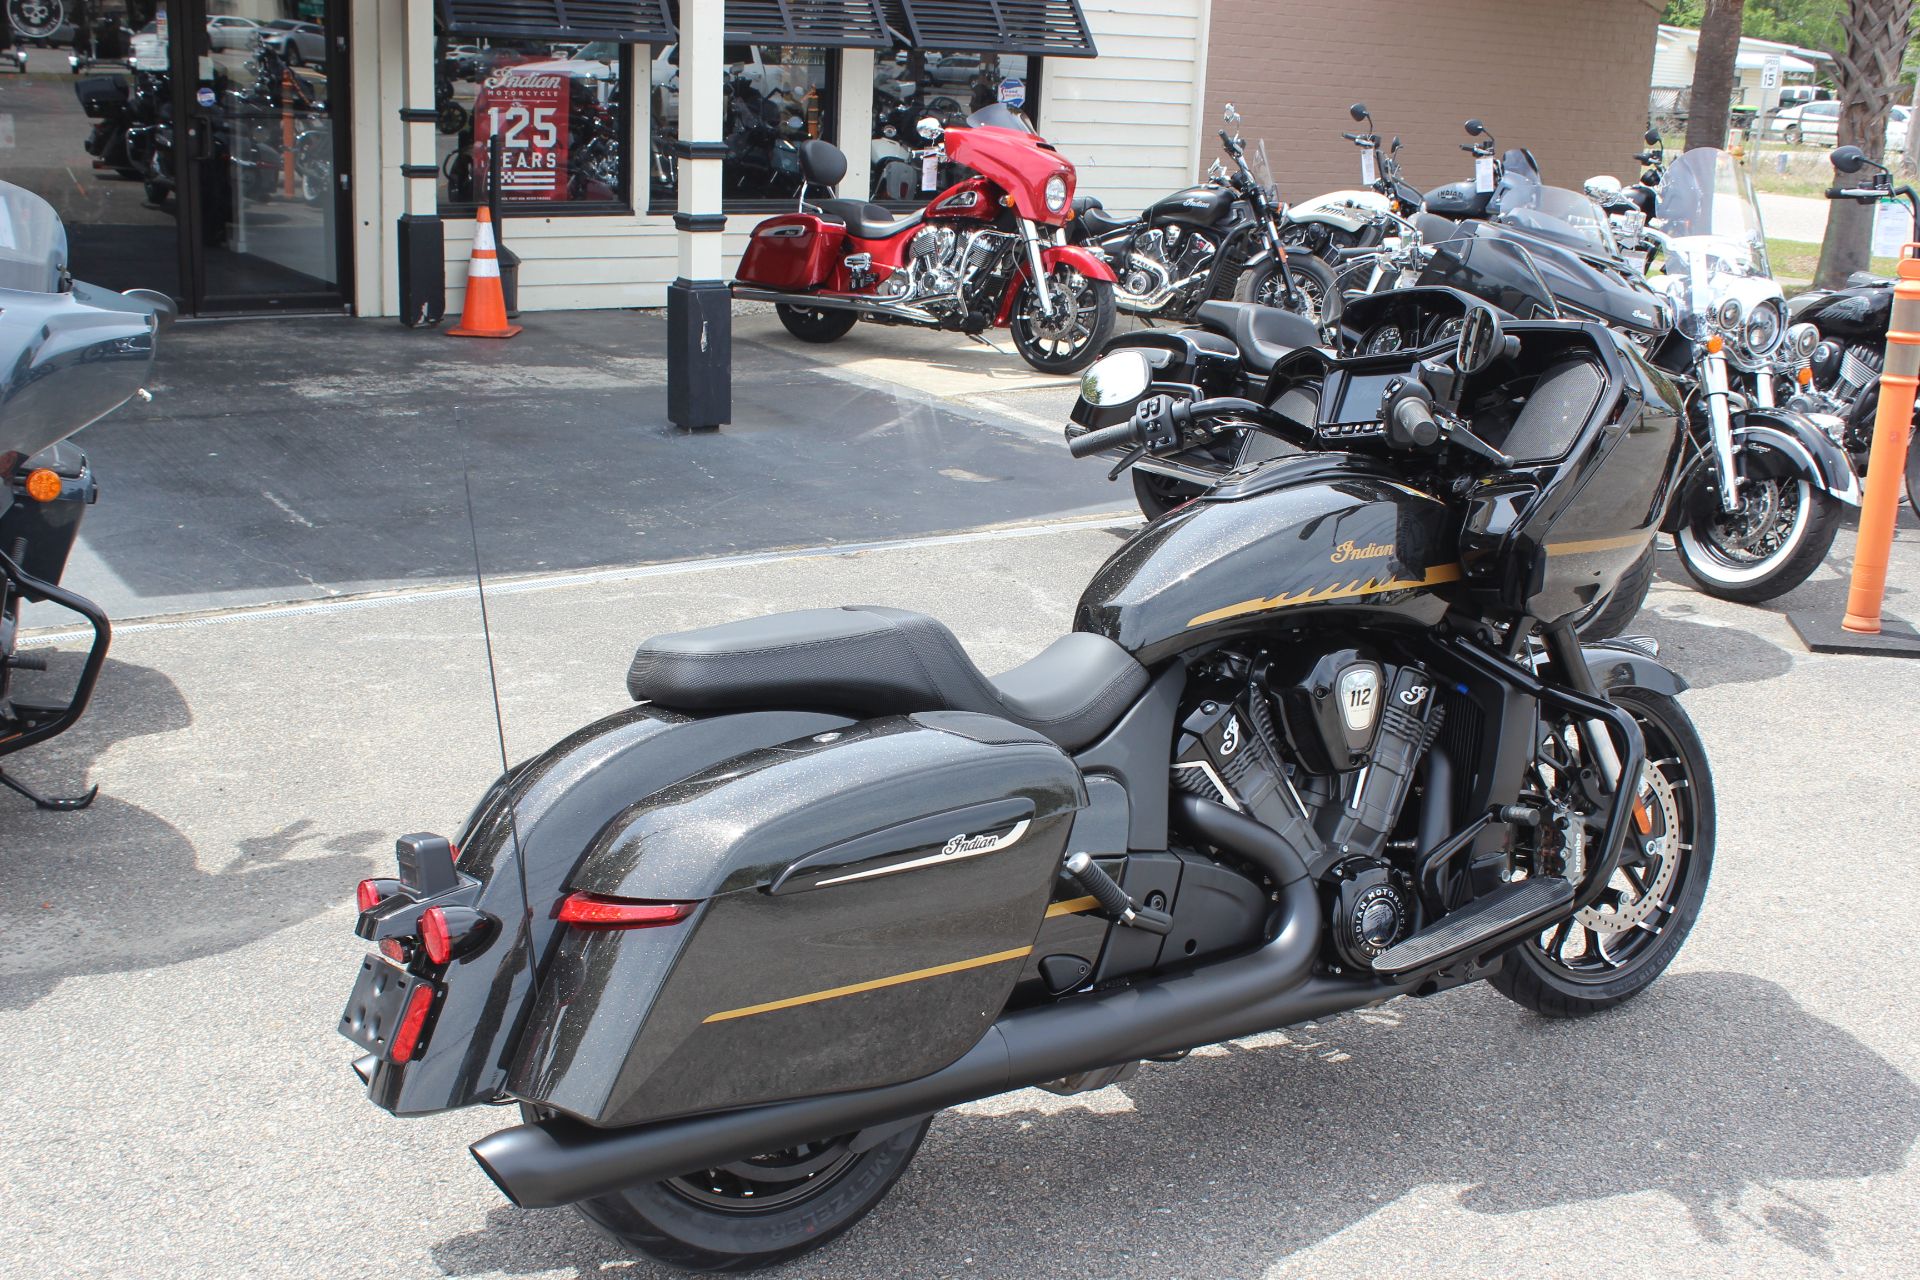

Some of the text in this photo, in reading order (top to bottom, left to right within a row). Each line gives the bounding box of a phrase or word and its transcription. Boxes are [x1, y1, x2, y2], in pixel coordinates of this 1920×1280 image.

[484, 66, 561, 89] Indian
[1763, 73, 1775, 87] 15
[487, 106, 557, 148] 125
[487, 151, 557, 168] EARS
[1183, 198, 1210, 208] Indian
[1330, 540, 1394, 564] Indian
[1350, 687, 1372, 707] 112
[942, 834, 998, 856] Indian
[1574, 832, 1582, 873] brembo
[1355, 901, 1368, 946] INDIAN
[771, 1151, 893, 1239] METZELER
